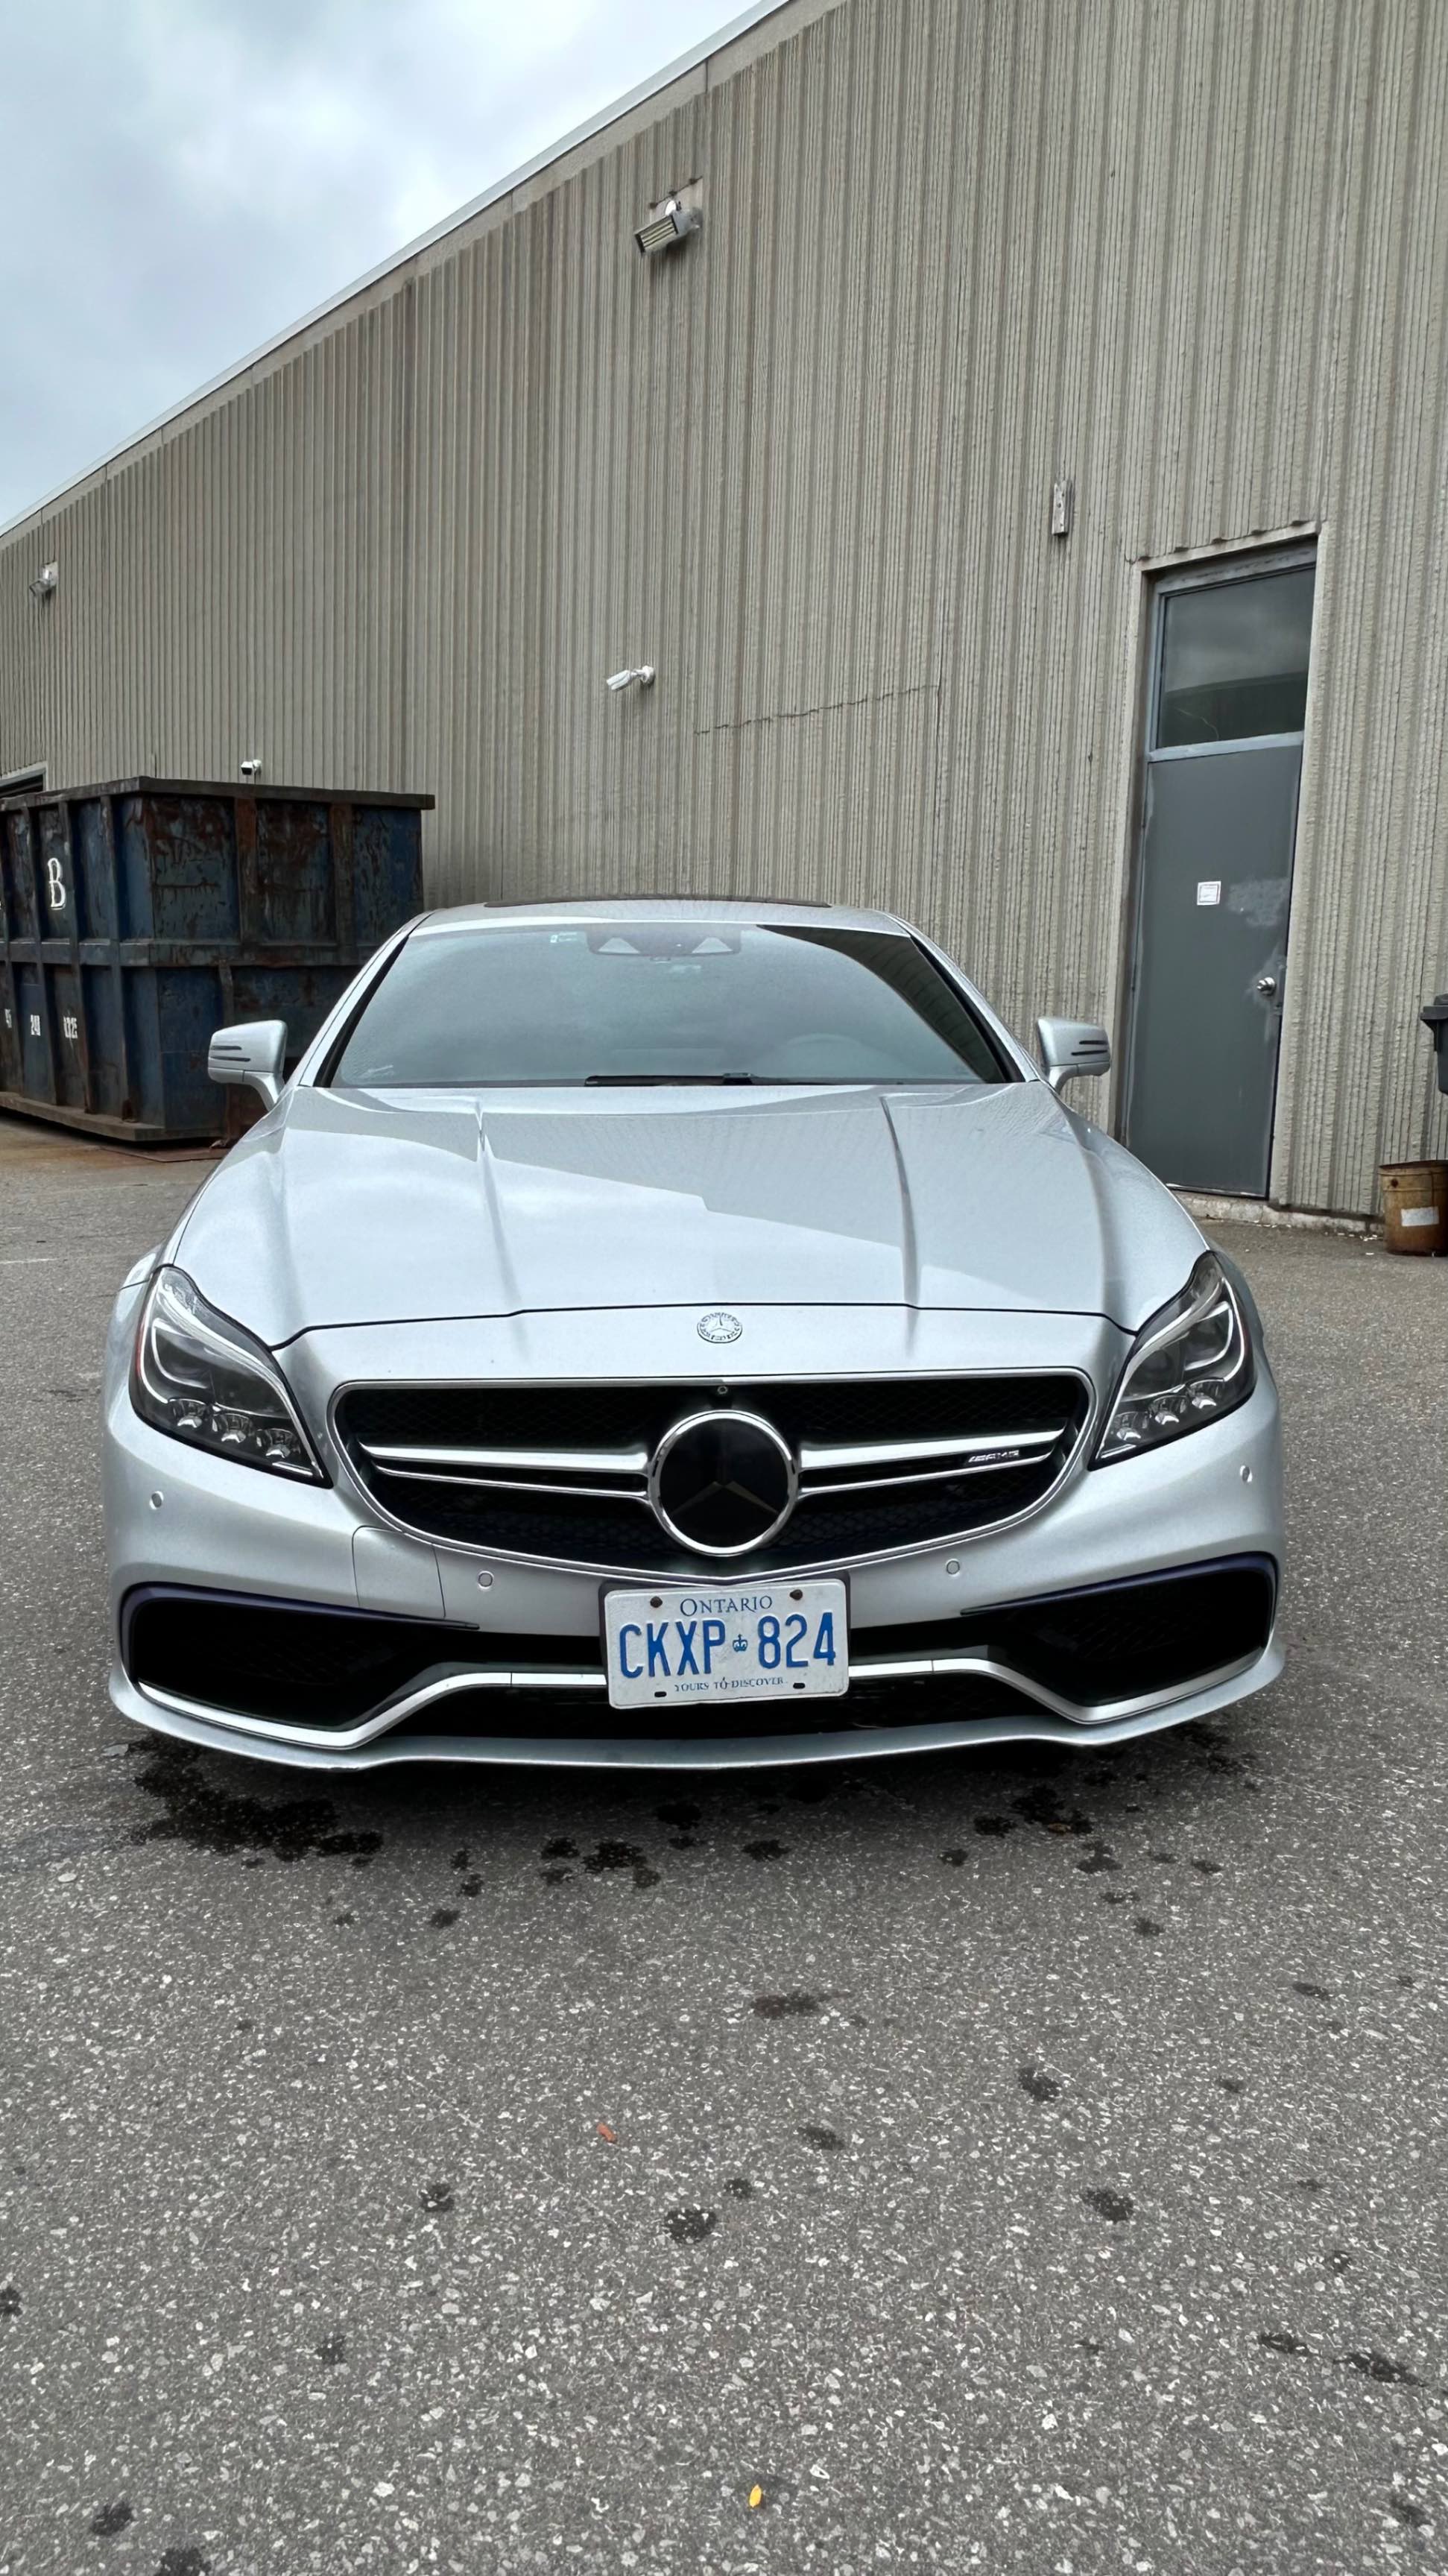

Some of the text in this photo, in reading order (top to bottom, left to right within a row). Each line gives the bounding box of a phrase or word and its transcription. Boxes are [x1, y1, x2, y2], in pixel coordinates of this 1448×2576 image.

[48, 857, 66, 910] B
[680, 1595, 773, 1617] ONTARIO
[619, 1611, 836, 1679] CKXP 824
[674, 1677, 784, 1692] YOURS TO DISCOVER
